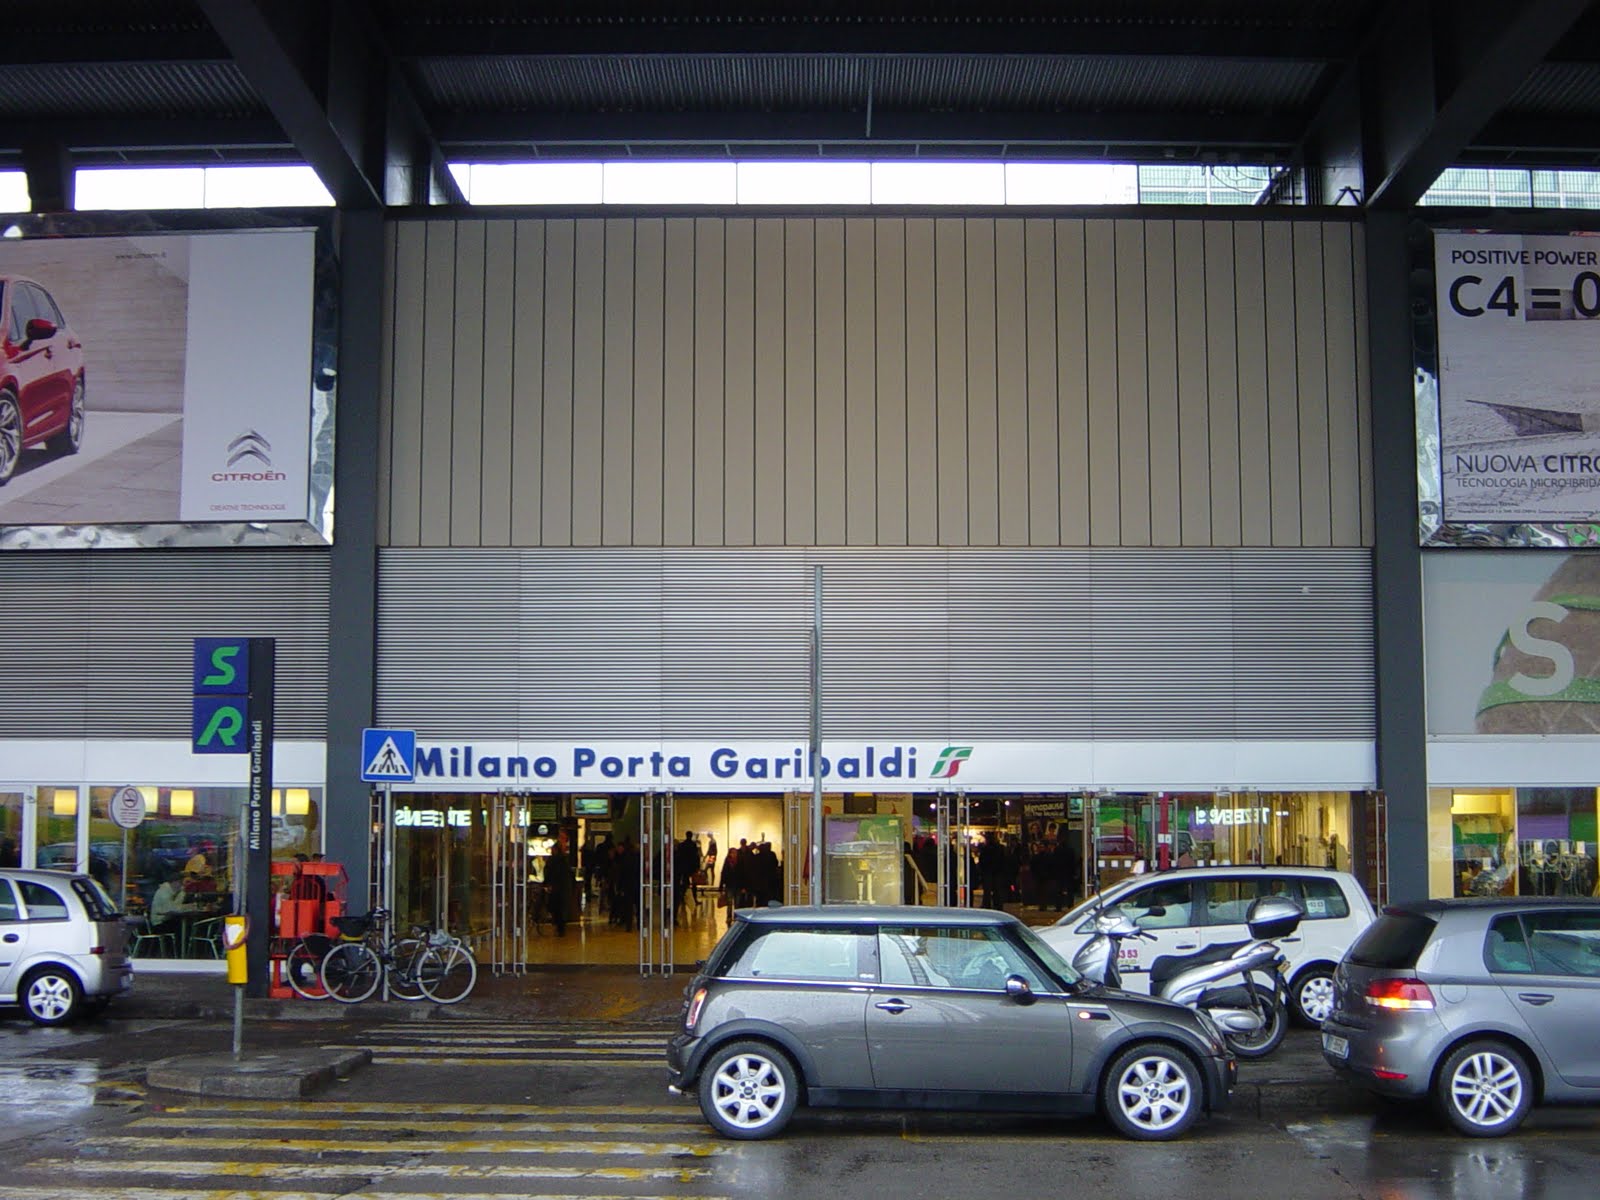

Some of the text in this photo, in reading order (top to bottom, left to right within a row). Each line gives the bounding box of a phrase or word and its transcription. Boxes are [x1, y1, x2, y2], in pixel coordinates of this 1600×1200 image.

[1451, 251, 1598, 266] POSITIVE POWER
[212, 471, 286, 482] CITROËN
[1456, 455, 1537, 473] NUOVA
[1456, 477, 1528, 488] TECNOLOGIA
[202, 646, 241, 686] S
[196, 706, 244, 746] R
[415, 746, 556, 779] Milano
[574, 746, 690, 779] Porta
[249, 720, 264, 850] Milano Porta Garibaldi
